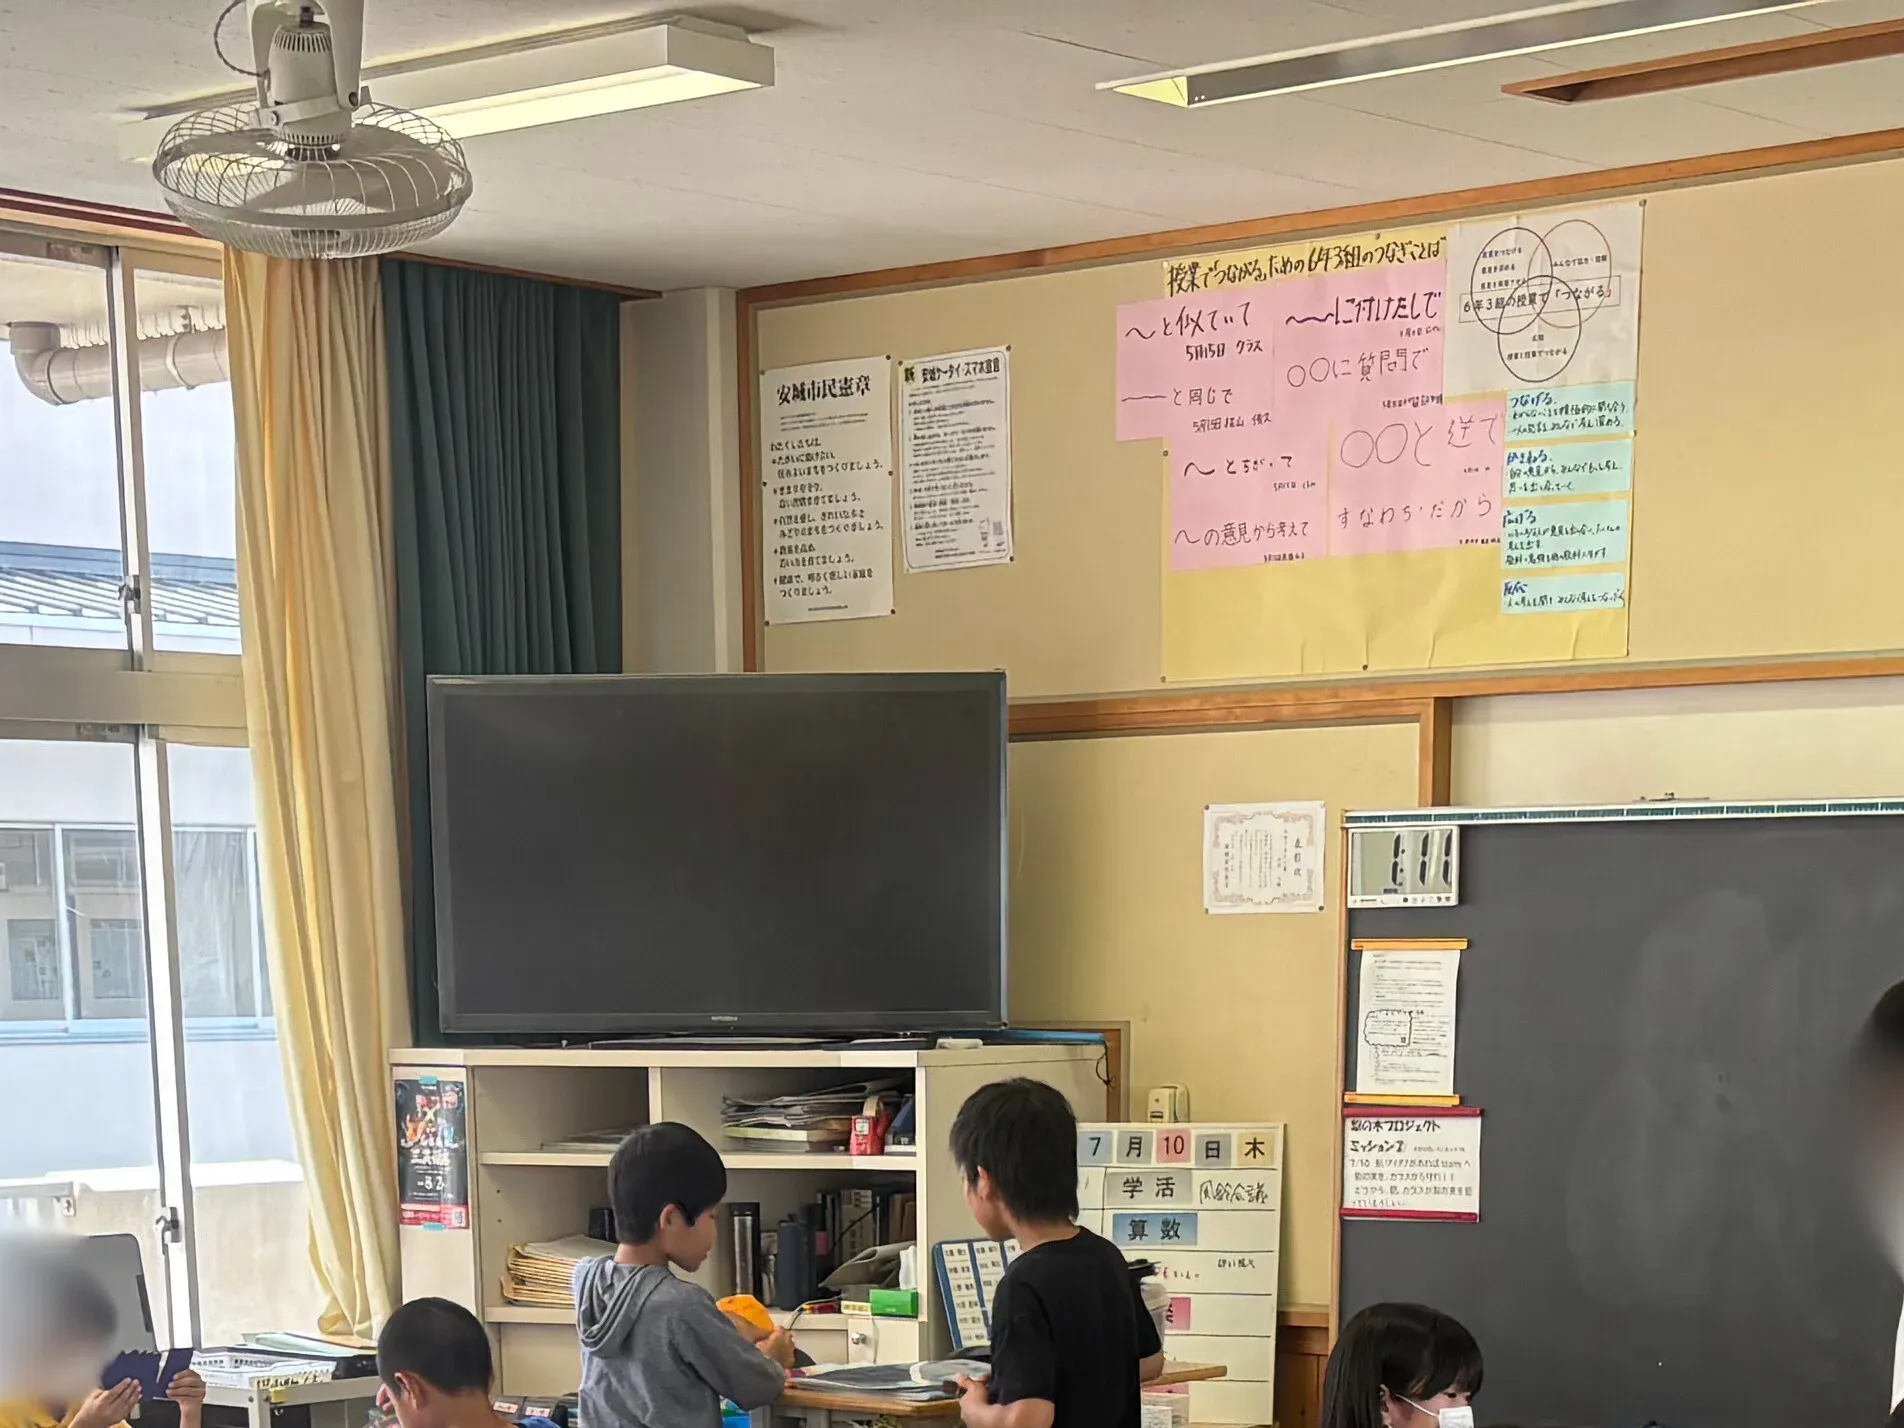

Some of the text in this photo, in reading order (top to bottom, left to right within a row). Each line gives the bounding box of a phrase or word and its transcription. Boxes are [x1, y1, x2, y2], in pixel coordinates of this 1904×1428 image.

[1088, 1135, 1265, 1159] 7 月 10 日 木
[1128, 1219, 1181, 1241] 算数
